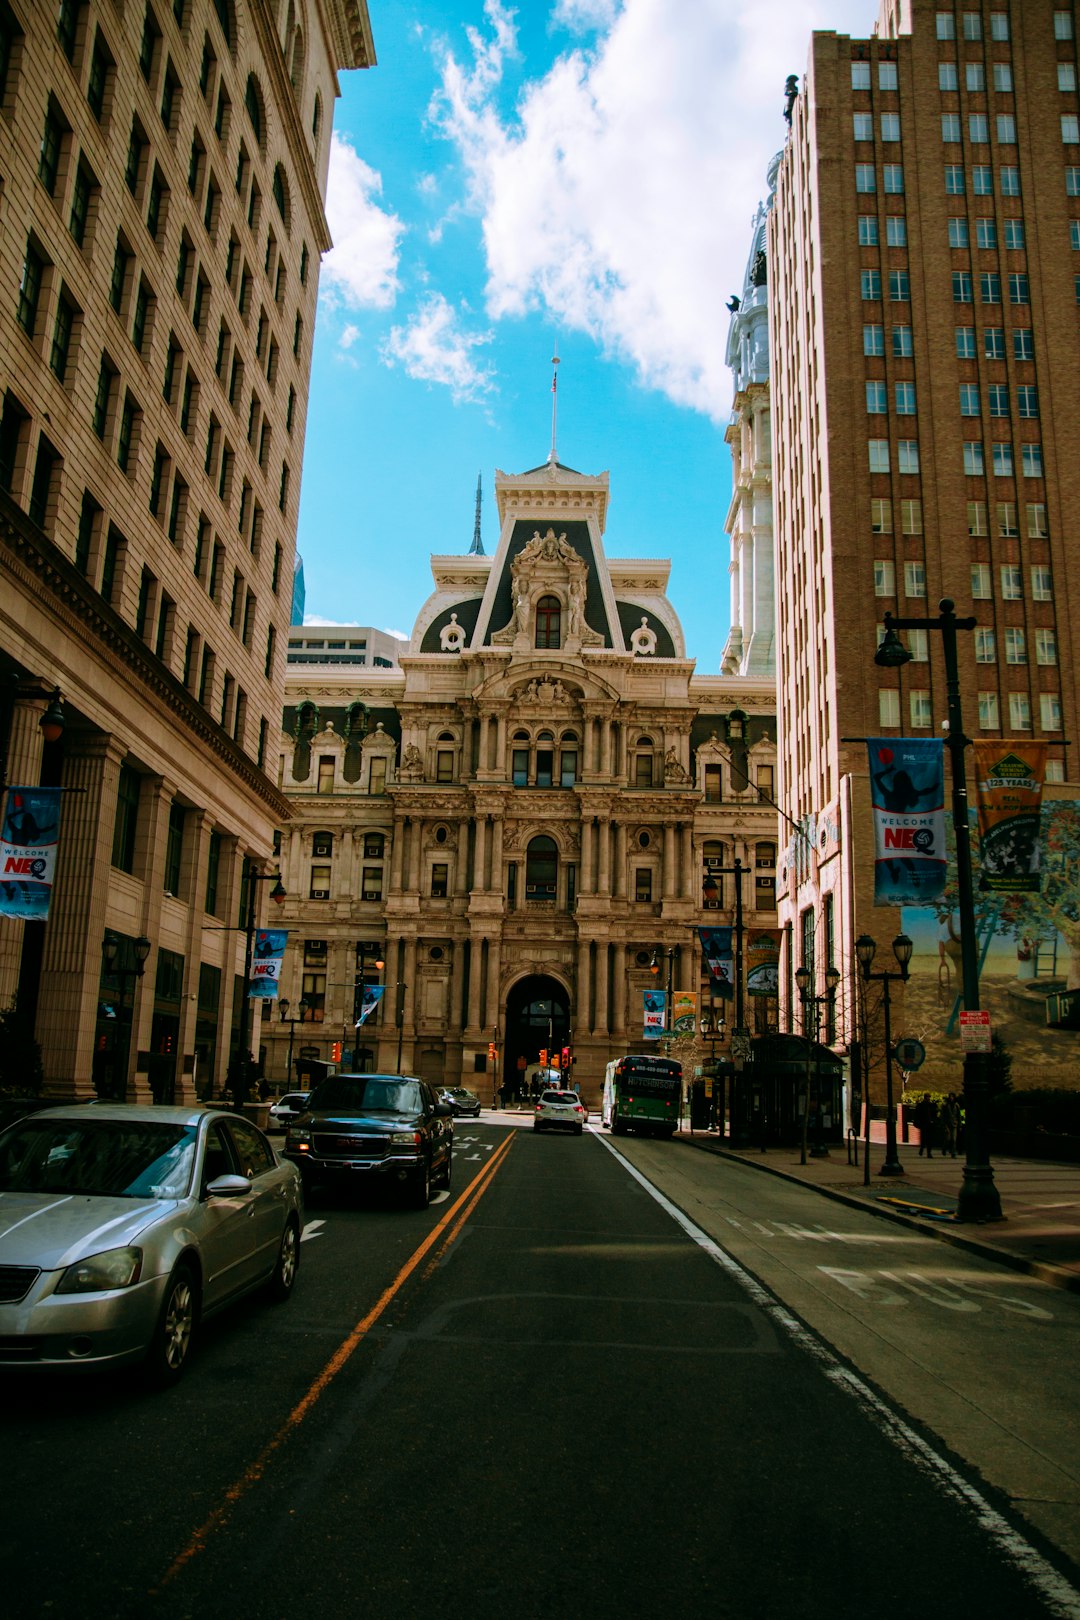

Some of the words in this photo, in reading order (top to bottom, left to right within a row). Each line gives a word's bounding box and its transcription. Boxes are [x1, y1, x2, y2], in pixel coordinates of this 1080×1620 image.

[1006, 779, 1032, 787] YEARS
[881, 818, 934, 826] WELCOME
[884, 828, 935, 856] NEQ
[4, 849, 49, 857] WELCOME
[4, 857, 46, 880] NEQ
[254, 965, 275, 977] NEQ
[647, 1016, 662, 1025] NEQ
[627, 1077, 675, 1090] HUTCHINSON
[816, 1266, 1055, 1320] BUS
